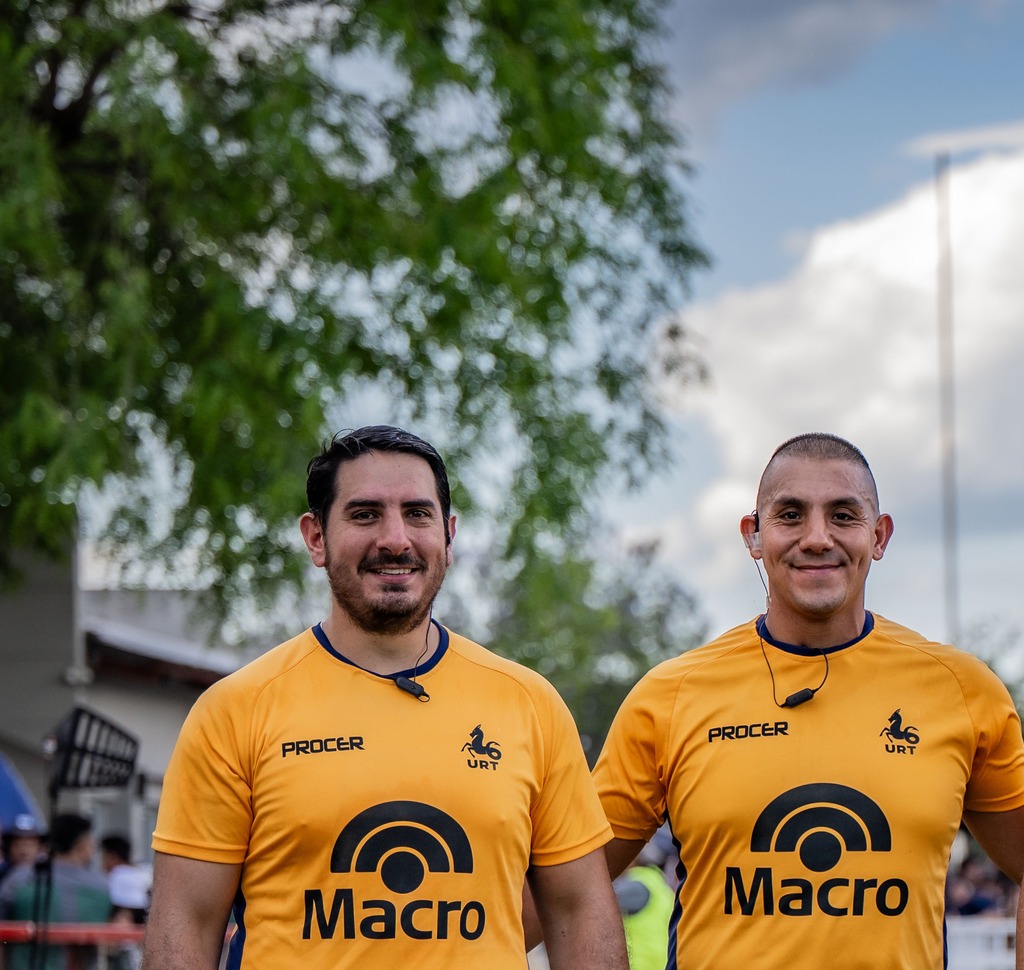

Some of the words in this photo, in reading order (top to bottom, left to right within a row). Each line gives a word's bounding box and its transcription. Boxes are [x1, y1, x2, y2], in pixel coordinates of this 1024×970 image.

[708, 721, 789, 743] PROCER
[281, 736, 364, 758] PROCER
[885, 742, 919, 755] URT
[467, 758, 500, 771] URT
[724, 868, 909, 919] Macro
[302, 889, 486, 941] Macro
